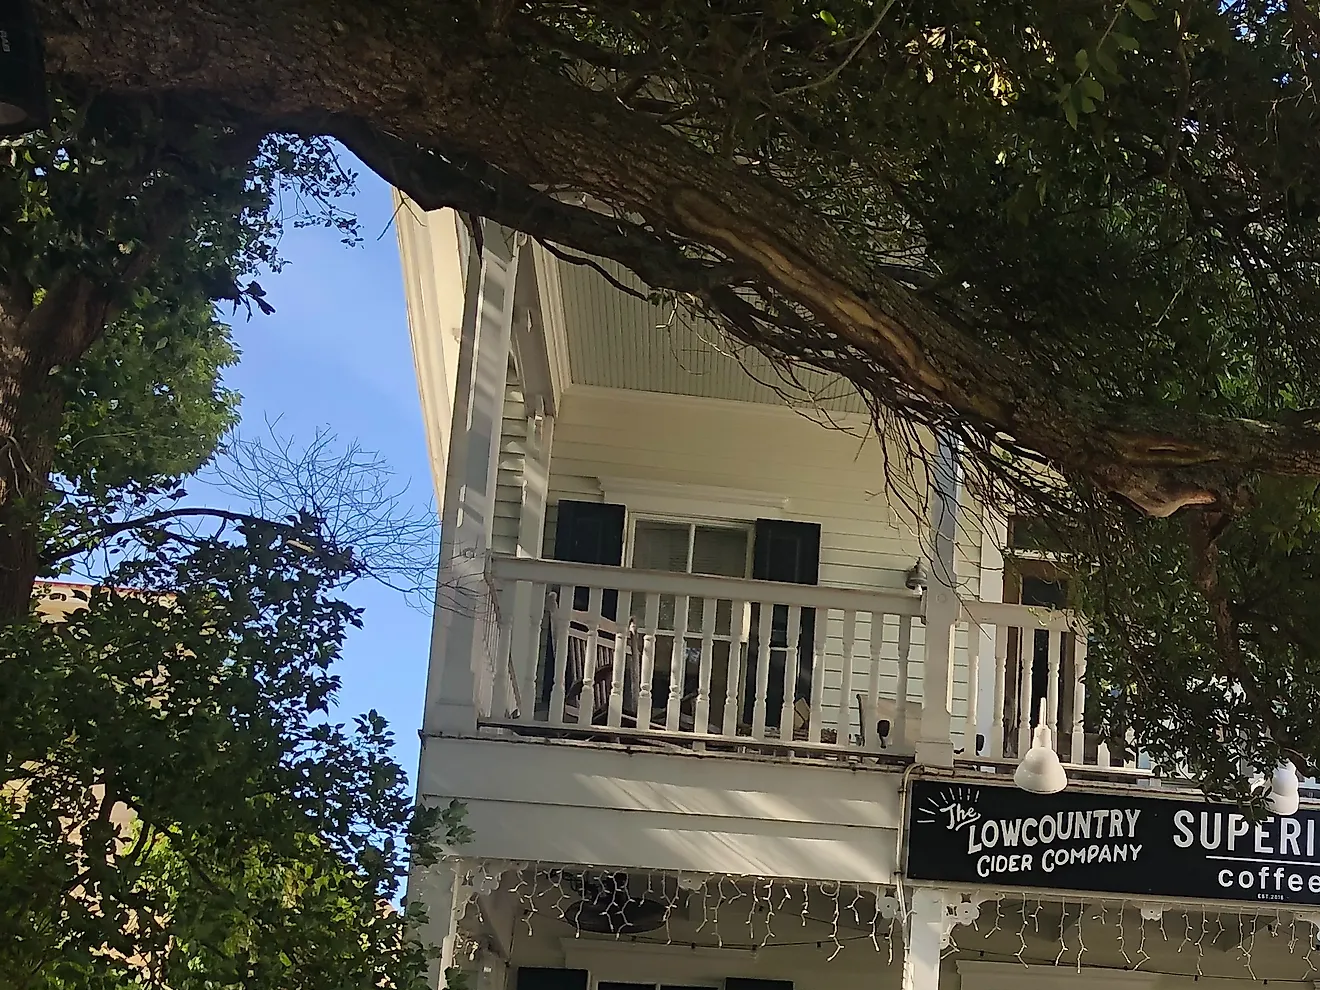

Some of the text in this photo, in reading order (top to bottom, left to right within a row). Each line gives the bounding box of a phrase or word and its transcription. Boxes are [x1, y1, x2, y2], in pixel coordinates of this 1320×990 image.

[939, 802, 981, 830] The
[967, 808, 1141, 854] LOWCOUNTRY
[976, 843, 1143, 878] CIDER COMPANY
